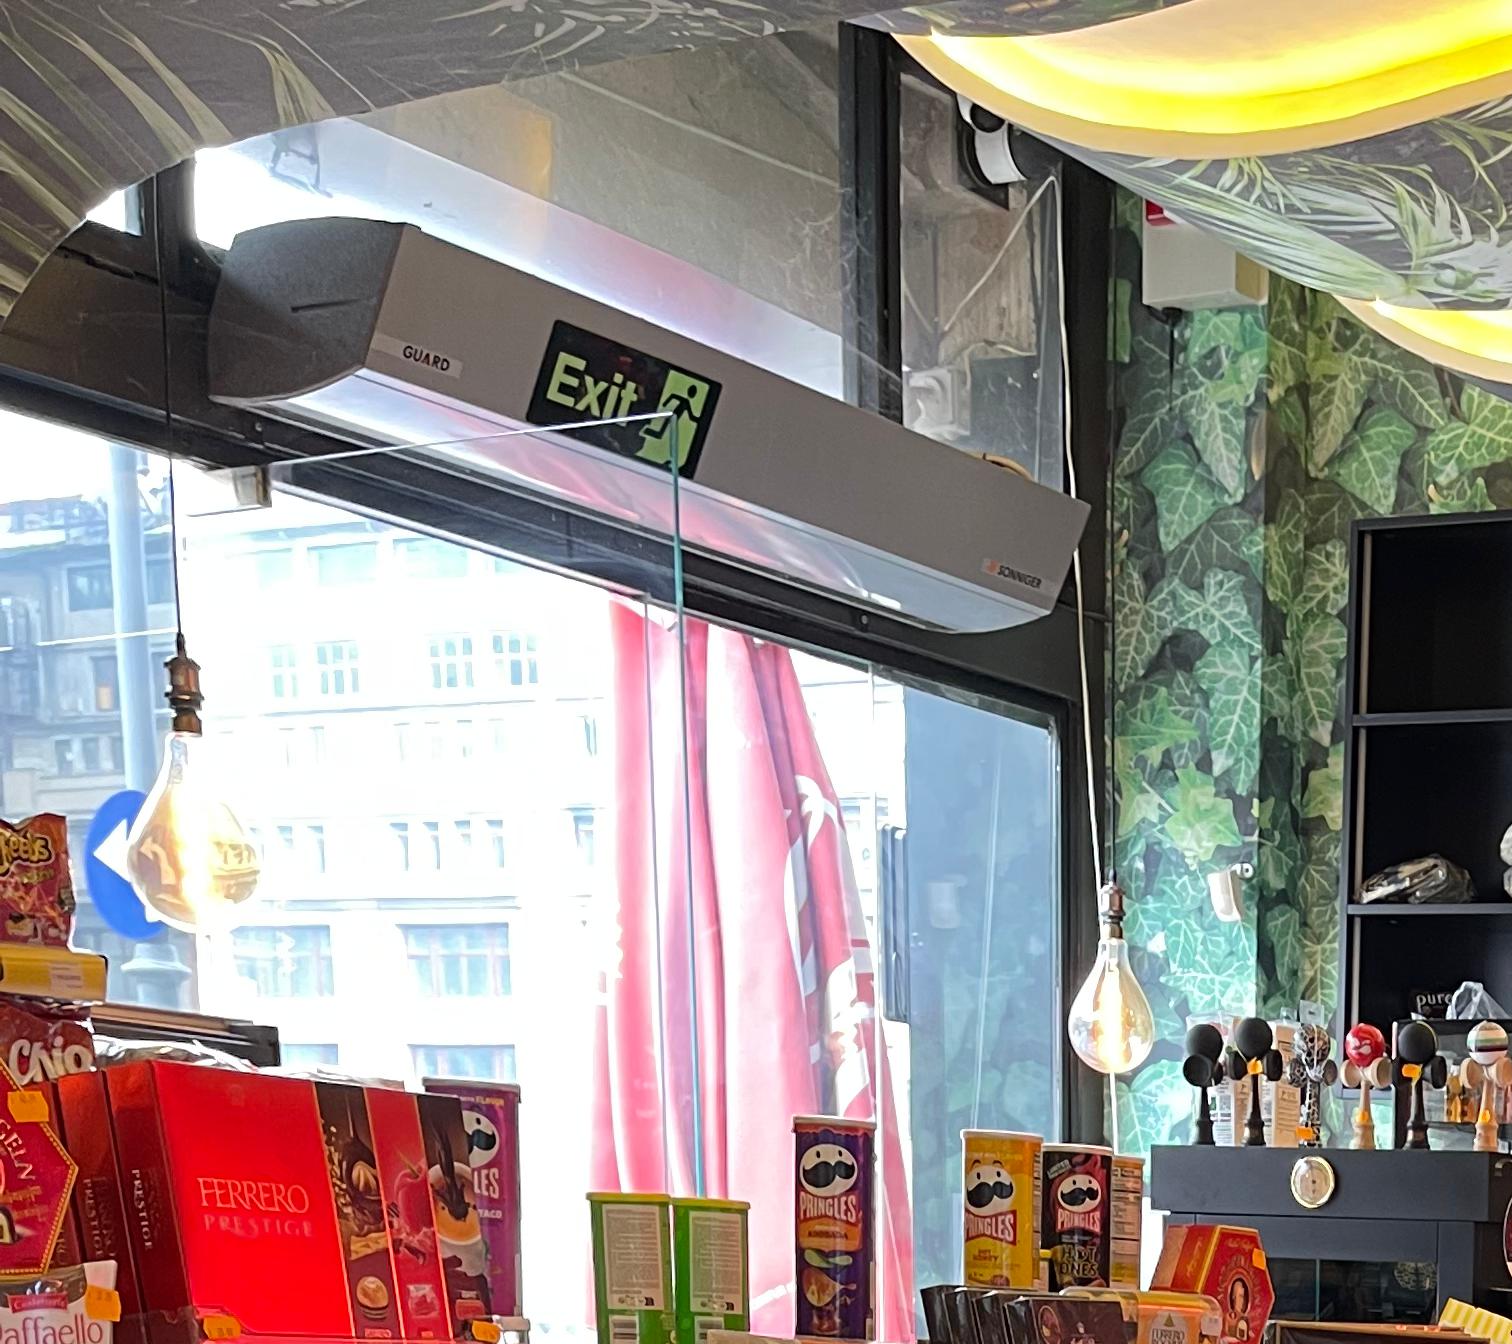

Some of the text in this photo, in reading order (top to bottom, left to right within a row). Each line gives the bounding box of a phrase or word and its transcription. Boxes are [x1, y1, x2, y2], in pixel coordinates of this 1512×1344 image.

[402, 344, 452, 374] GUARD
[546, 351, 641, 427] Exit
[9, 1036, 93, 1086] Chio
[197, 1176, 309, 1215] FERRERO
[799, 1195, 858, 1223] PRINGLES
[204, 1217, 313, 1239] PRESTIGE
[965, 1214, 1015, 1243] PRINGLES
